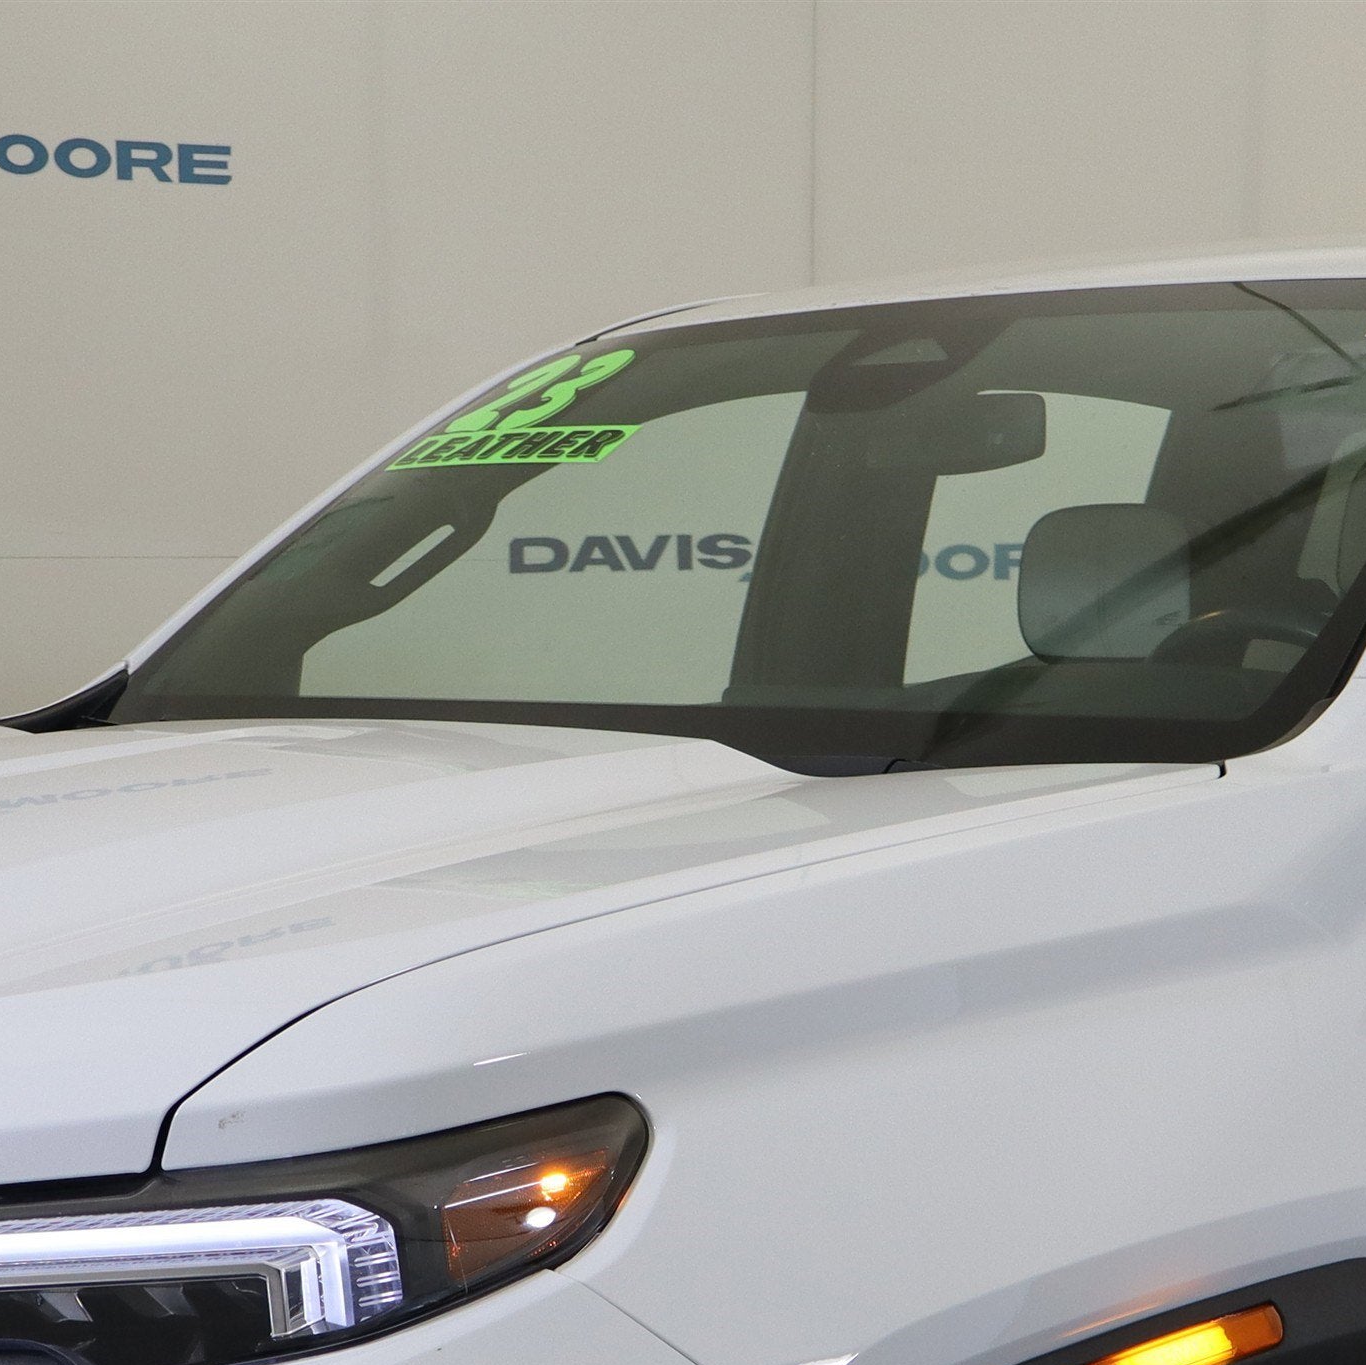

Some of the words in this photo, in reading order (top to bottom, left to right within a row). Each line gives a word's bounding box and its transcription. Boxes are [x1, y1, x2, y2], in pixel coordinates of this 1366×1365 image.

[444, 349, 636, 434] 23
[393, 428, 627, 467] LEATHER
[508, 532, 755, 575] DAVIS
